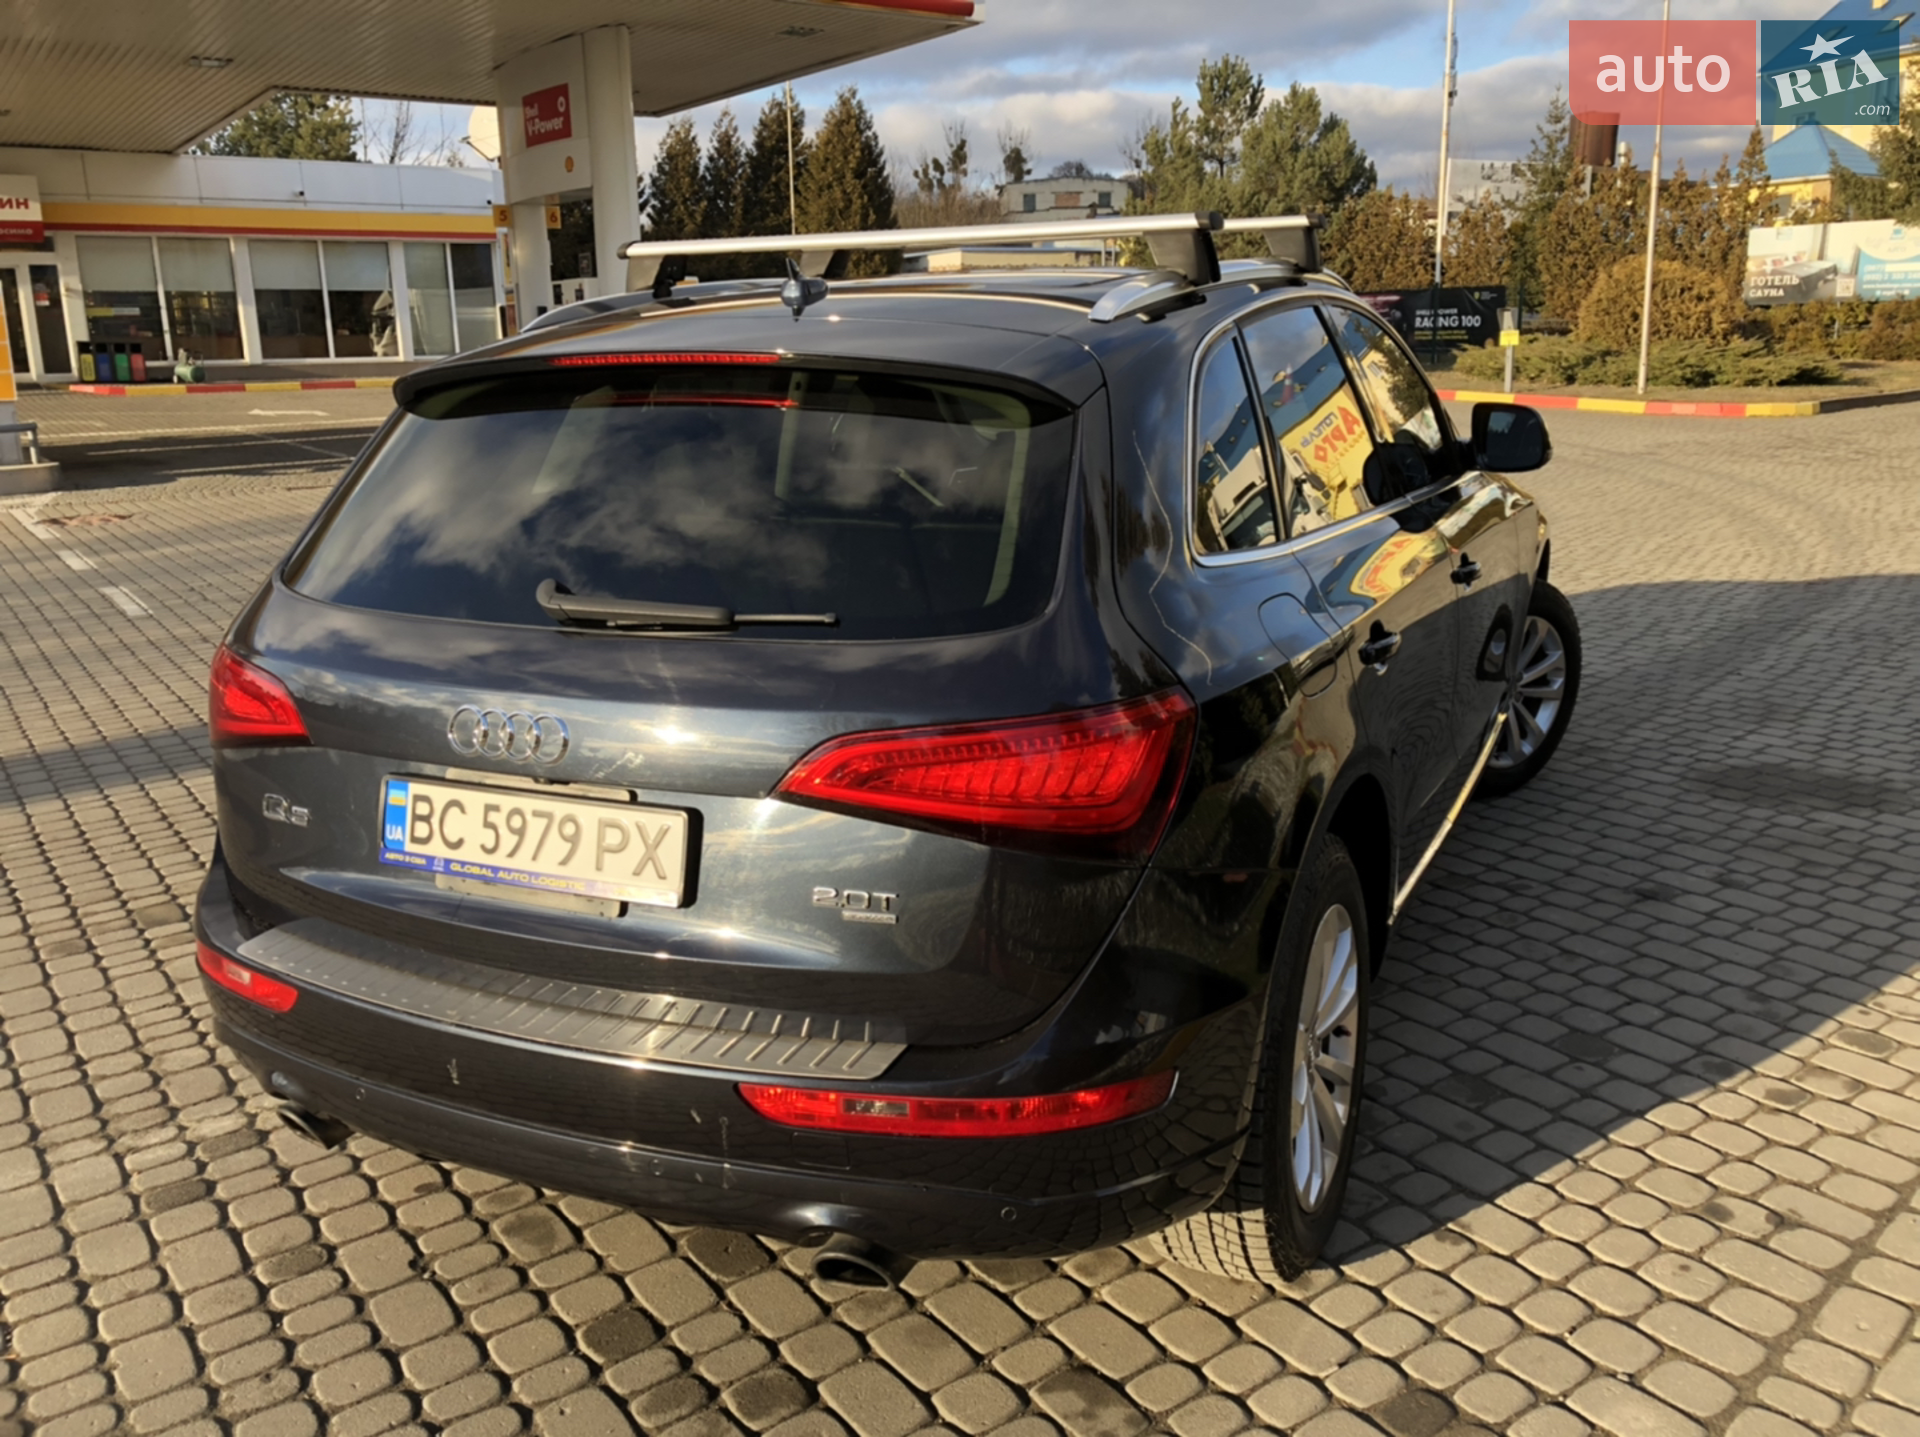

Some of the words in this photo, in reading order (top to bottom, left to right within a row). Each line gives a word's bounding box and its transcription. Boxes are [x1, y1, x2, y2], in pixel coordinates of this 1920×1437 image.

[526, 116, 564, 136] V-Power
[499, 209, 508, 222] 5
[549, 211, 558, 223] 6
[1750, 274, 1800, 287] ГОТЕЛЬ
[1749, 288, 1785, 297] САУНА
[1461, 315, 1482, 328] 100
[262, 793, 310, 827] Q5
[386, 824, 404, 842] UA
[410, 794, 467, 850] BC
[480, 803, 582, 867] 5979
[595, 816, 671, 880] PX
[450, 862, 494, 877] GLOBAL
[497, 869, 529, 883] AUTO
[531, 875, 586, 890] LOGISTIC
[813, 886, 899, 911] 2.0T
